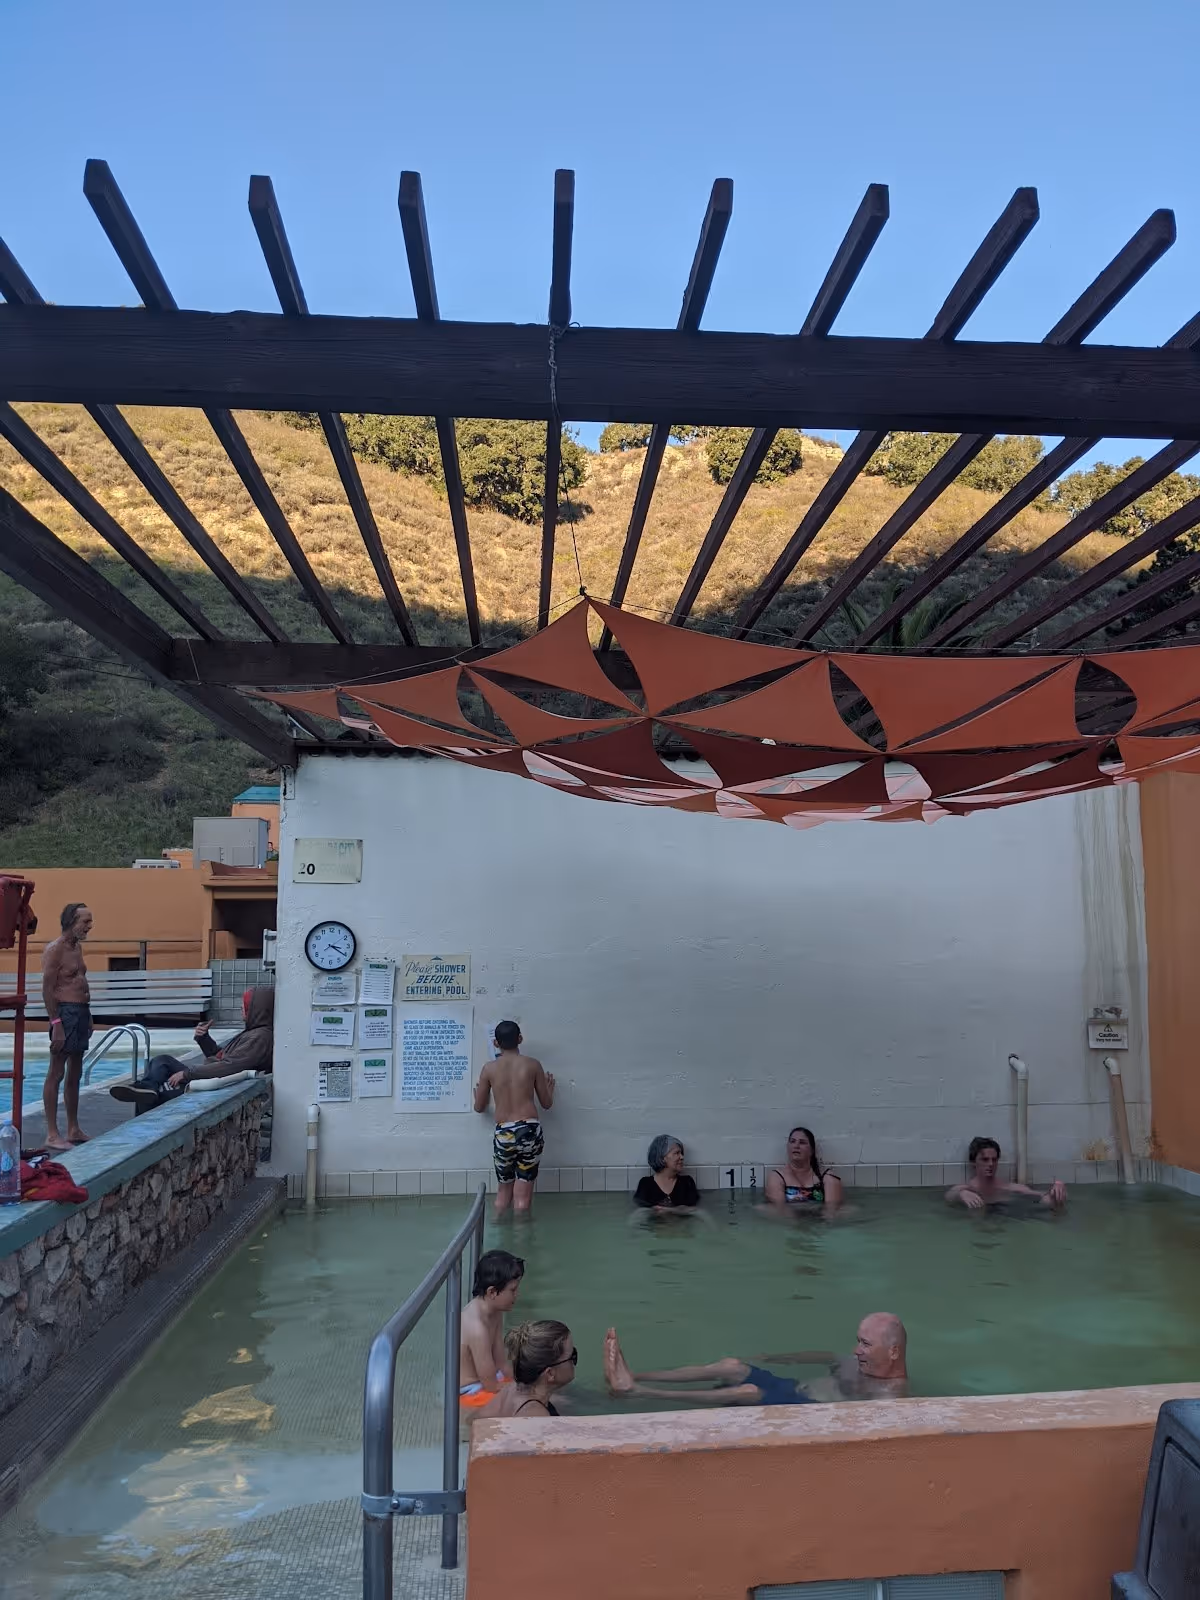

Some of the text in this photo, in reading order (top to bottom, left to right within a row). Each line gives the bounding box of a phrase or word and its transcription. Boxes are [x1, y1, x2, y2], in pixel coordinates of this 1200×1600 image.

[434, 964, 466, 973] SHOWER
[416, 974, 456, 984] BEFORE
[406, 985, 467, 995] ENTERING POOL
[726, 1168, 735, 1188] 1
